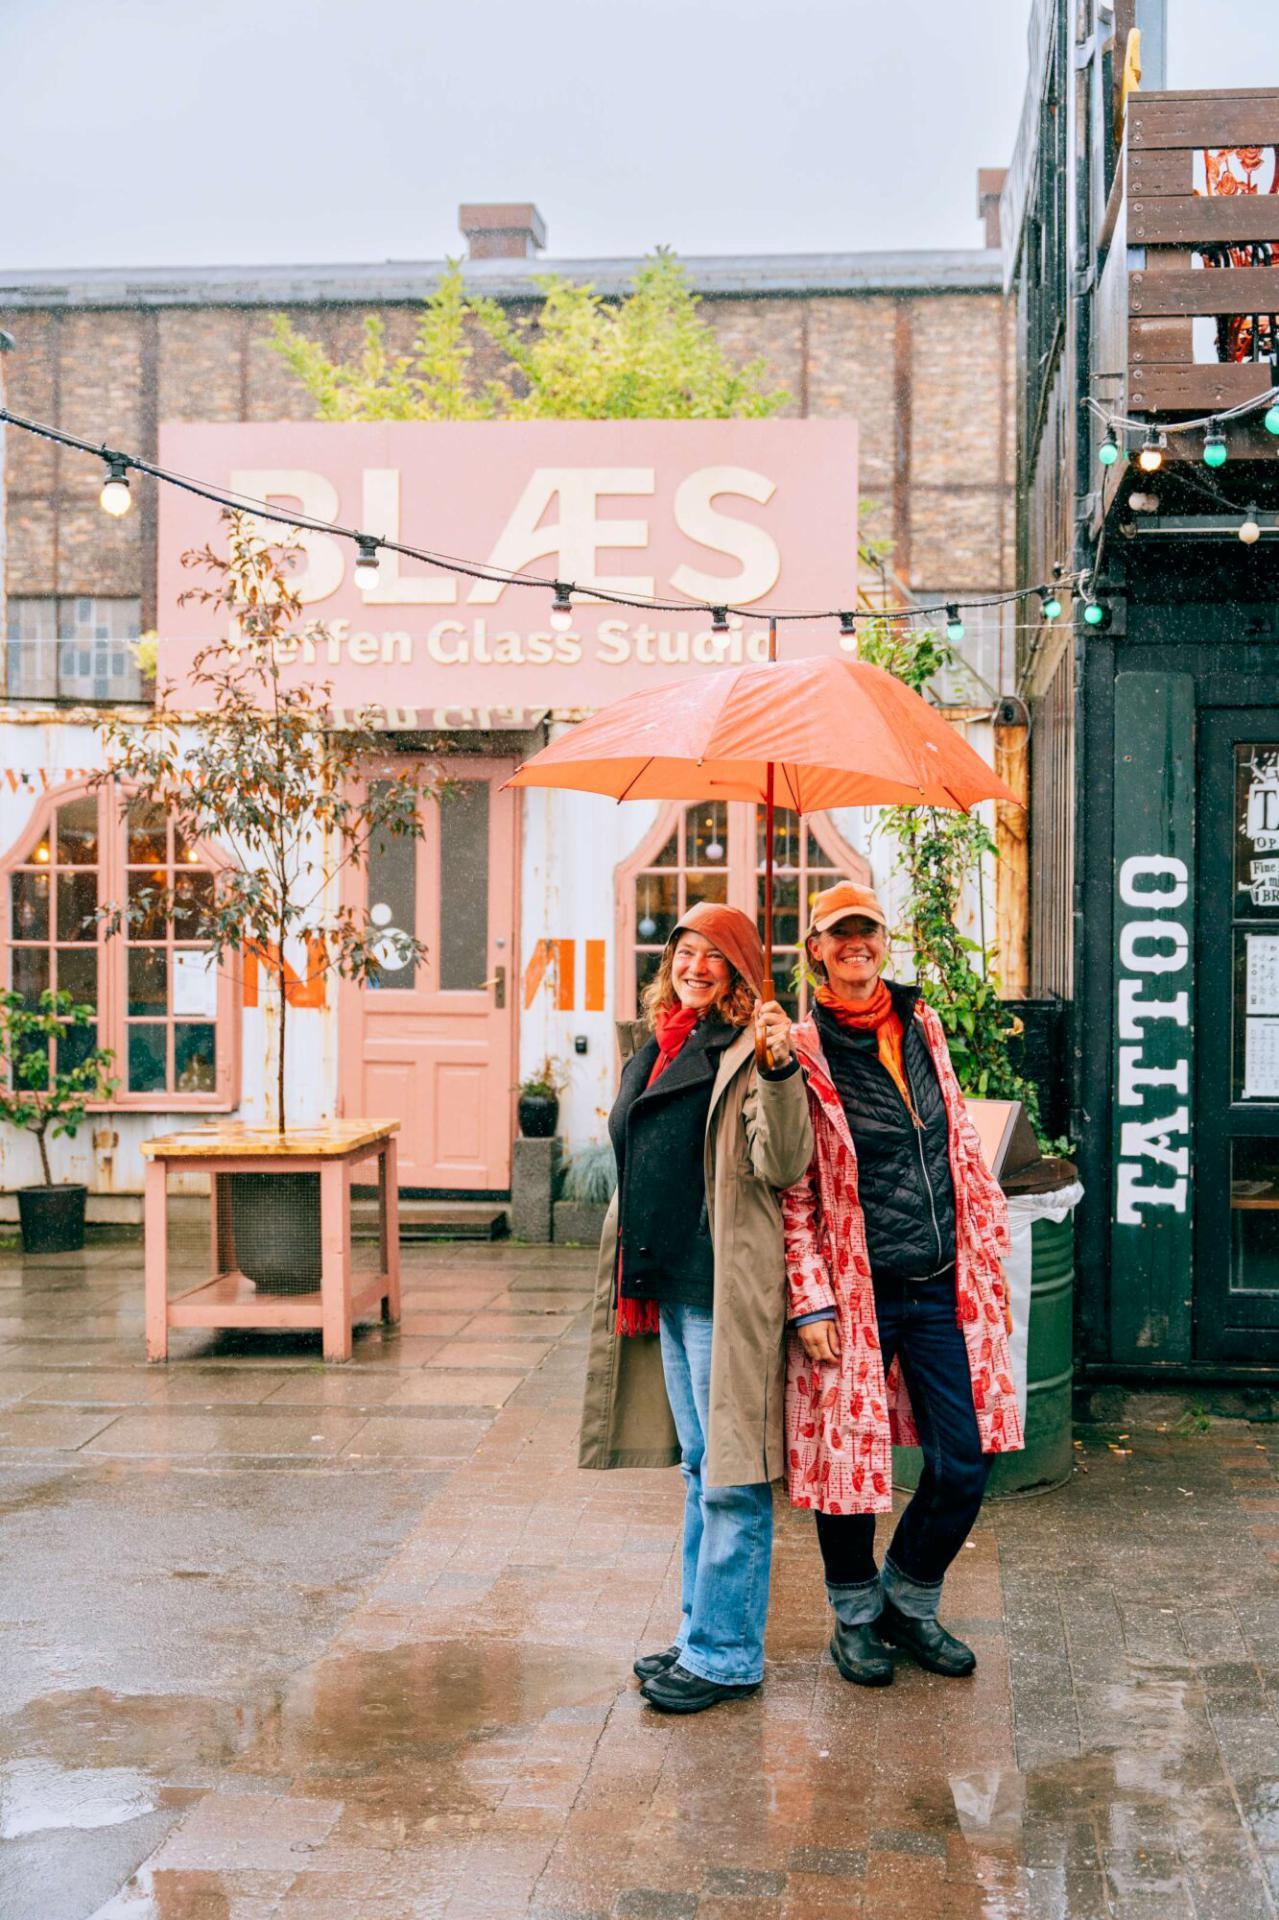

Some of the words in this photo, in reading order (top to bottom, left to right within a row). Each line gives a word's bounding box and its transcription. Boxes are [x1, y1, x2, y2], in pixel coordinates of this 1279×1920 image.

[229, 466, 781, 606] BLÆS
[427, 617, 583, 665] Glass
[597, 616, 780, 664] Studio
[1116, 854, 1189, 1226] TATTOO
